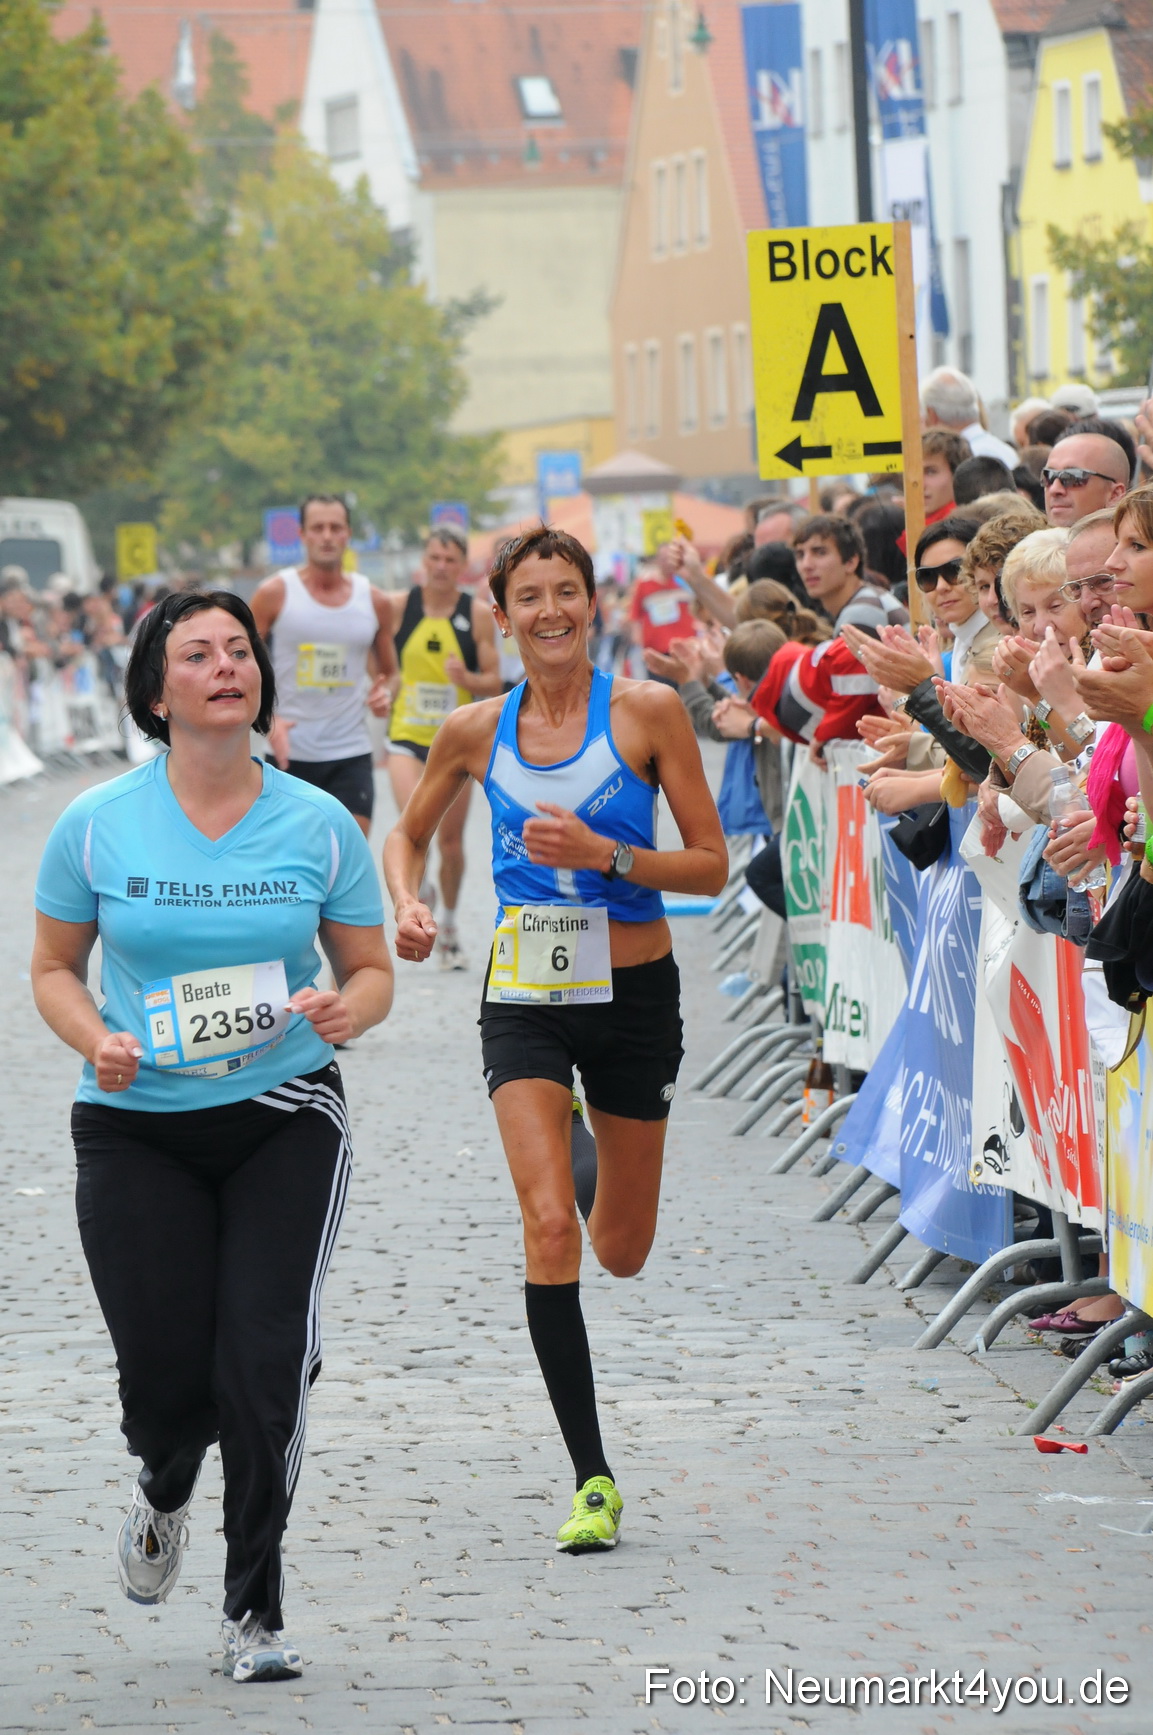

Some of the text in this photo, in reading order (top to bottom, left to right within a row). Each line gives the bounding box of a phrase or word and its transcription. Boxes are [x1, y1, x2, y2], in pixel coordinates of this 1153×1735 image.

[768, 234, 893, 282] Block
[791, 302, 884, 422] A
[587, 775, 623, 817] 2XU
[156, 880, 299, 898] TELIS FINANZ
[154, 896, 302, 908] DIREKTION ACHHAMMER
[522, 913, 589, 933] Christine
[498, 941, 506, 955] A
[551, 945, 569, 972] 6
[182, 981, 231, 1003] Beate
[563, 986, 610, 997] PFLEIDERER
[156, 1020, 165, 1035] C
[189, 1002, 276, 1045] 2358
